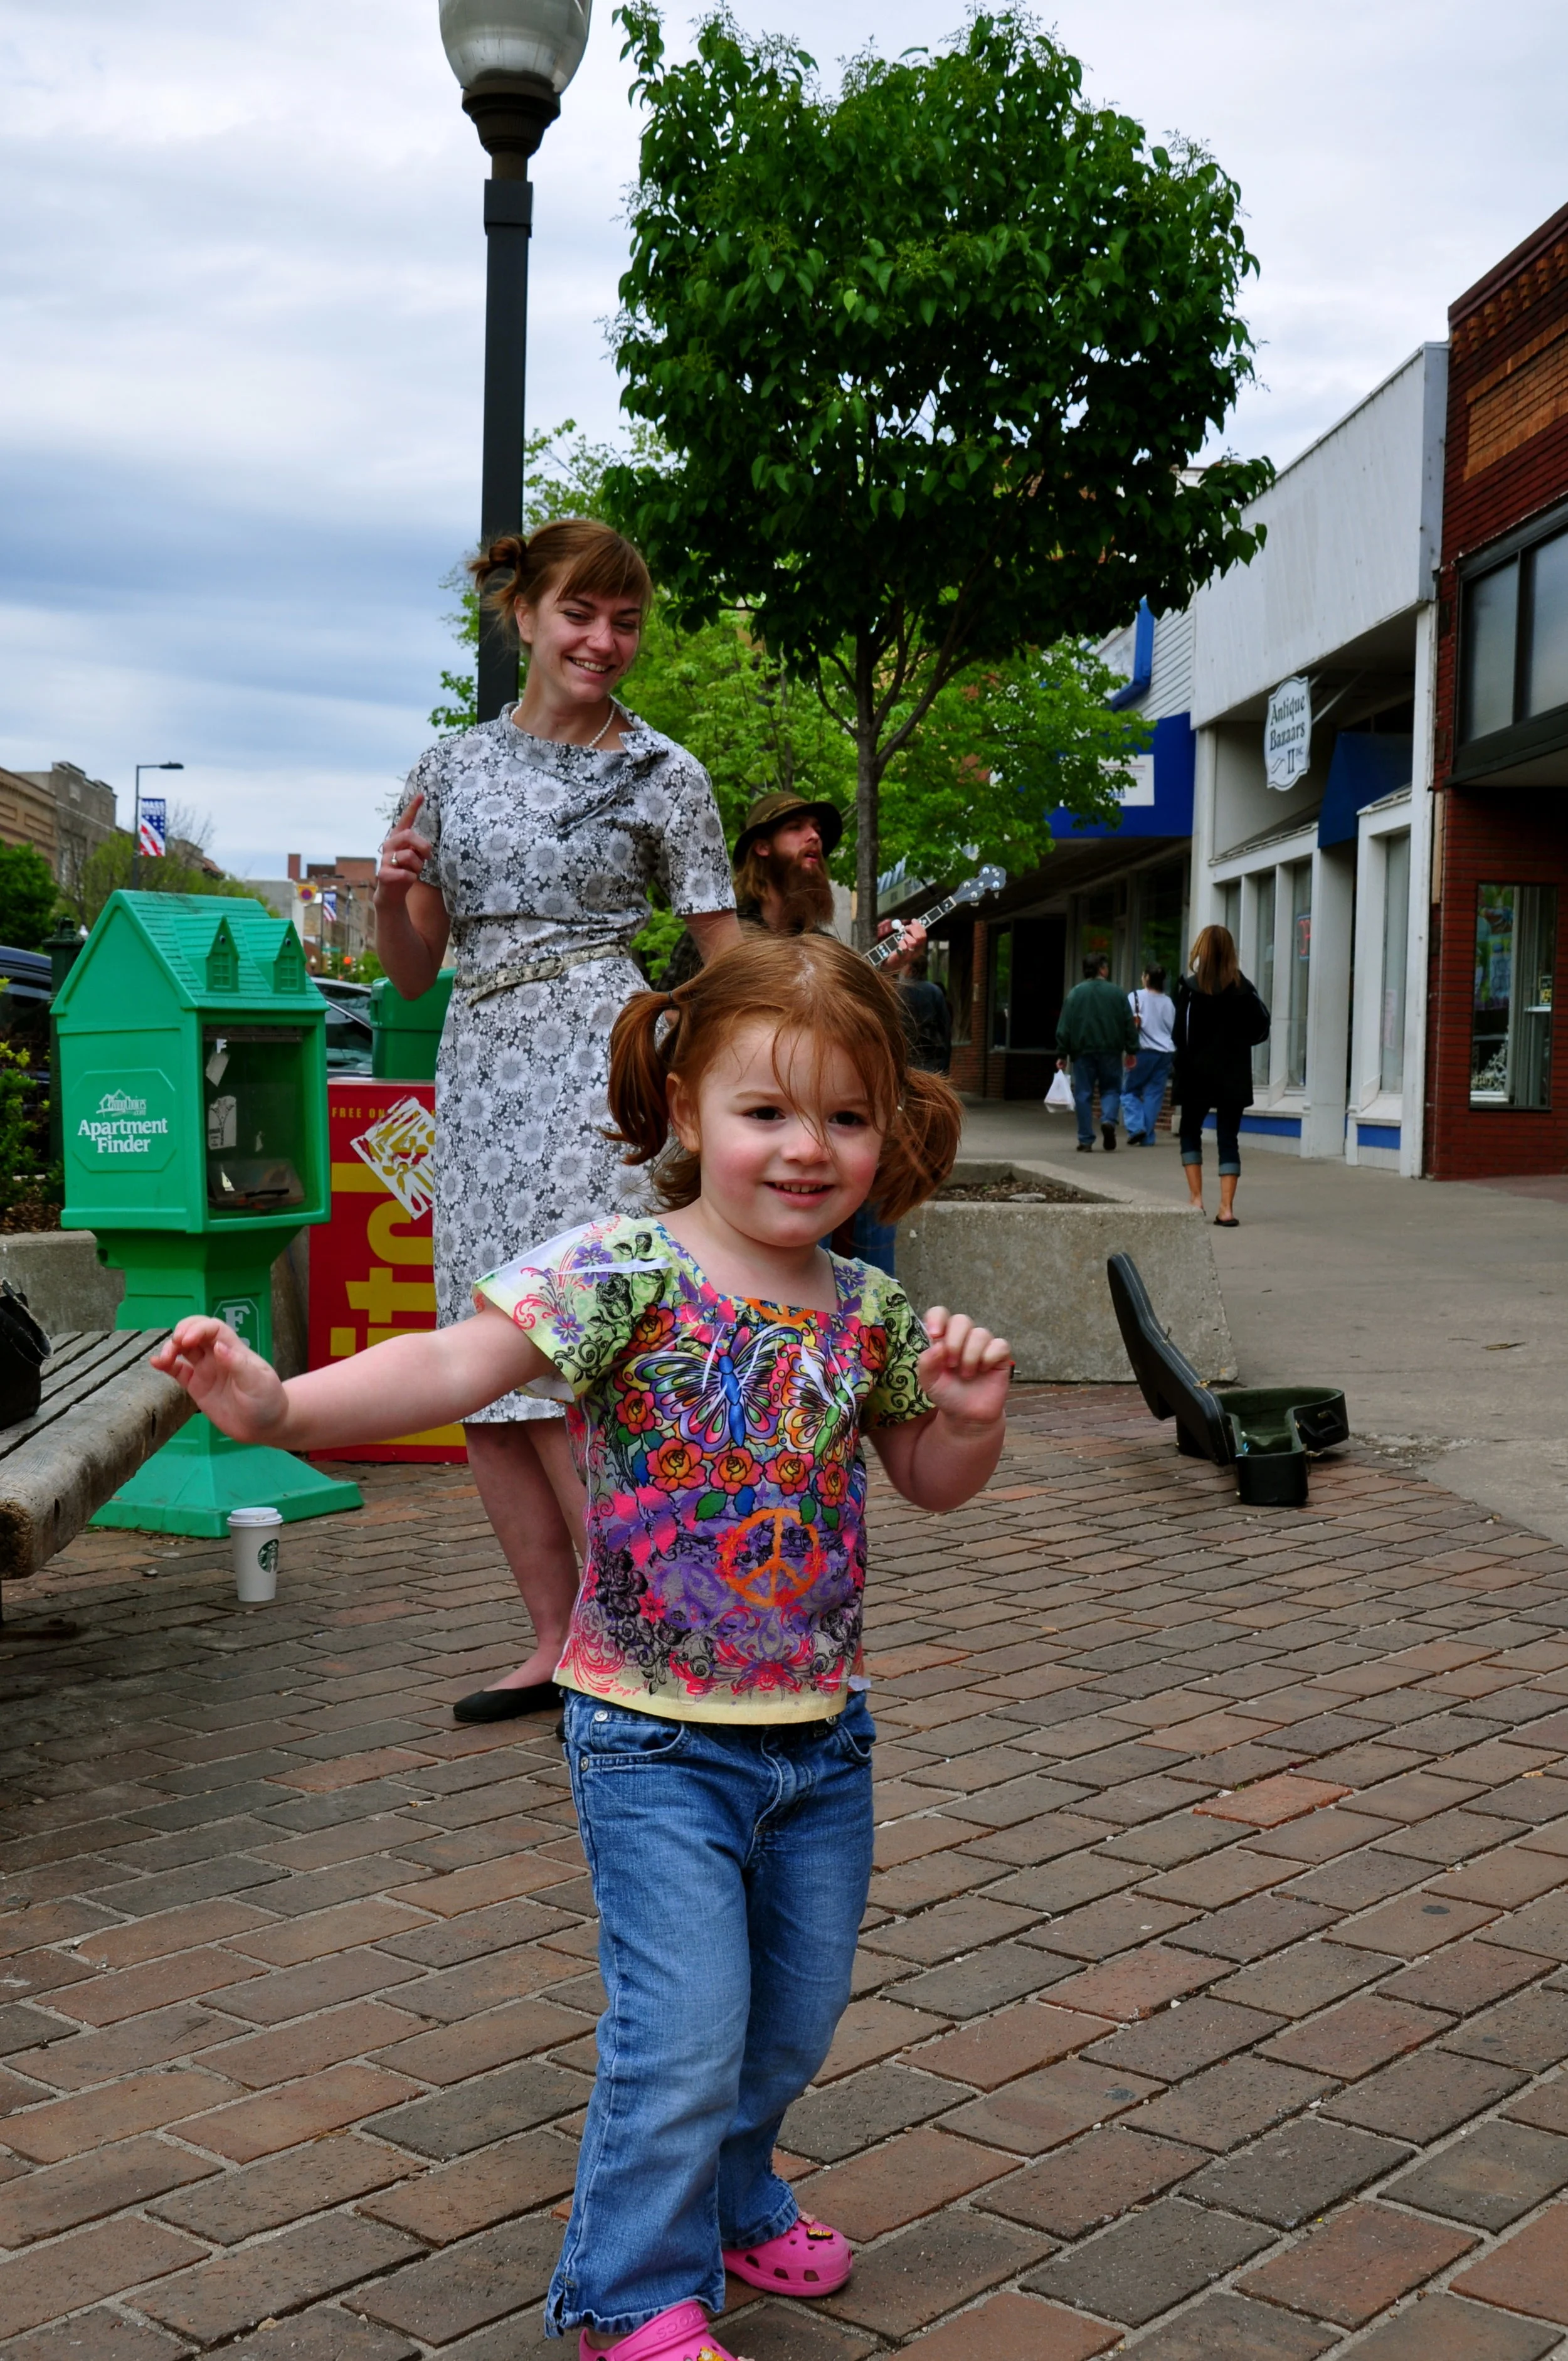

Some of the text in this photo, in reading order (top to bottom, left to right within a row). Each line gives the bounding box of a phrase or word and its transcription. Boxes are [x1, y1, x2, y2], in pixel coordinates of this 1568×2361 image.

[1271, 696, 1305, 726] Antique
[1270, 721, 1305, 751] Bazaars
[1288, 748, 1295, 774] II
[332, 1107, 362, 1118] FREE
[77, 1118, 168, 1141] Apartment
[97, 1135, 151, 1153] Finder
[656, 2310, 702, 2340] crocs
